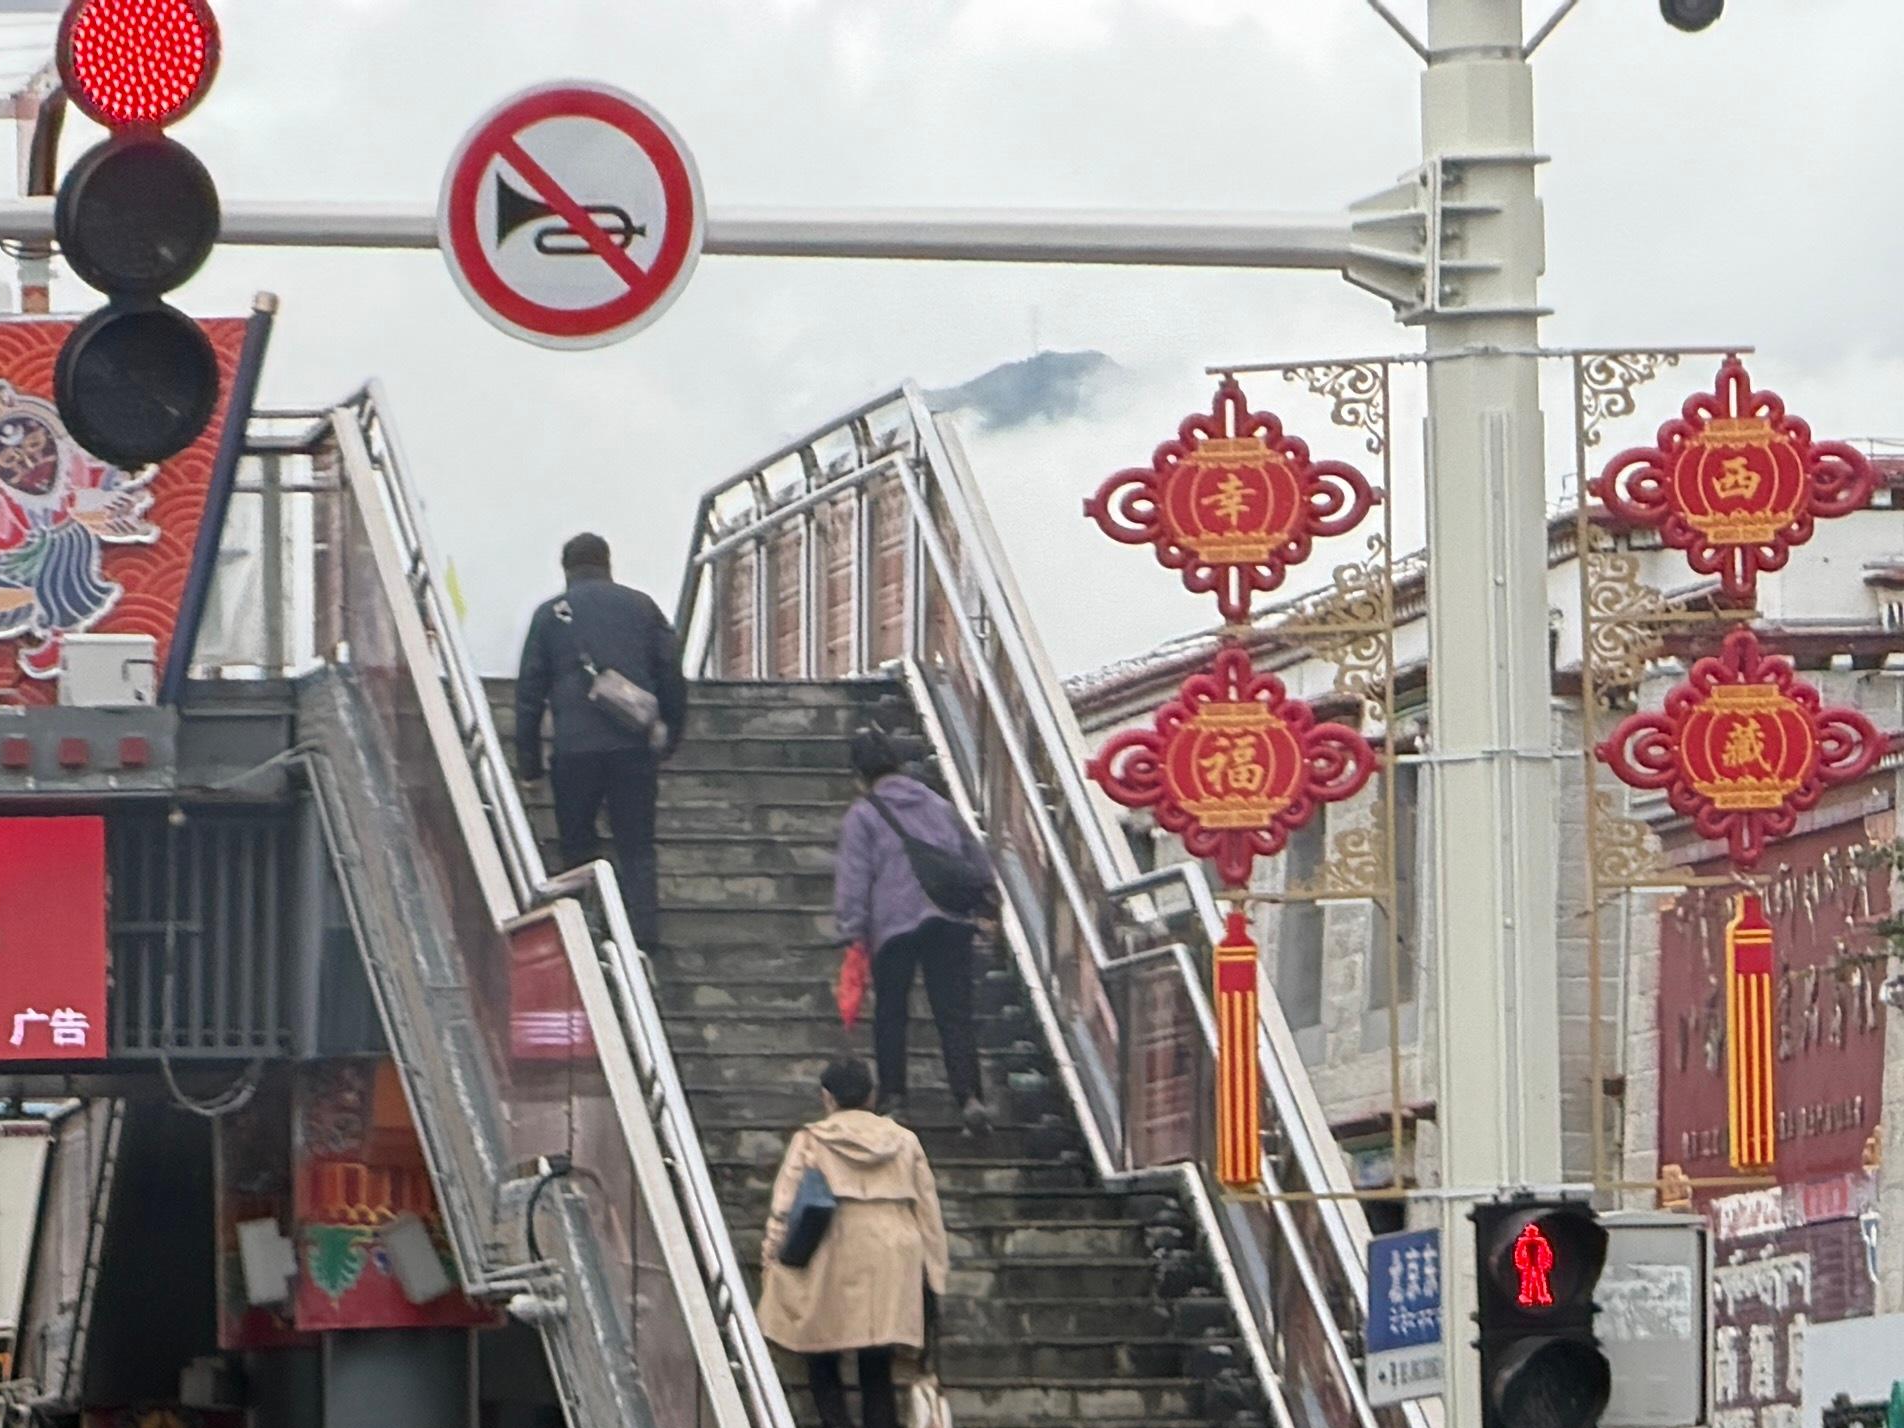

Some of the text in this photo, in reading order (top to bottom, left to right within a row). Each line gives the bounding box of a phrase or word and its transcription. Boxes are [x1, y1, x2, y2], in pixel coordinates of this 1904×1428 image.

[1200, 472, 1258, 527] 幸
[1711, 457, 1761, 501] 西
[1200, 732, 1267, 795] 福
[1722, 719, 1773, 775] 藏
[9, 1006, 91, 1048] 广告
